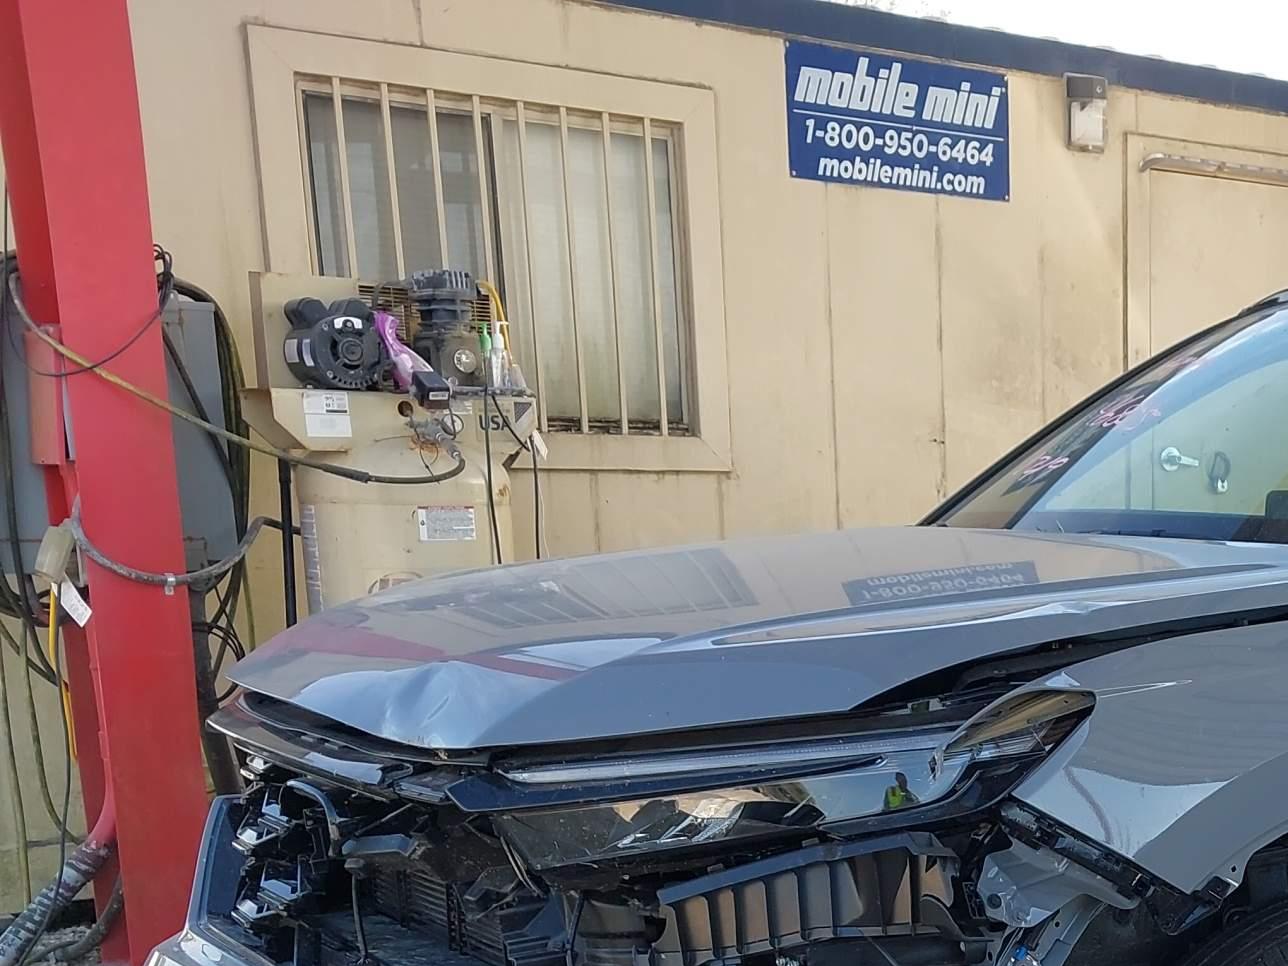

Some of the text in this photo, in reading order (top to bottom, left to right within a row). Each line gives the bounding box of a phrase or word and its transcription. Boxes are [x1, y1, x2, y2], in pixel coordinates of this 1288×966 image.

[794, 56, 1001, 129] mobile mini
[804, 118, 994, 166] 1-800-950-6464
[818, 156, 985, 194] mobilemini.com
[479, 415, 511, 431] USA
